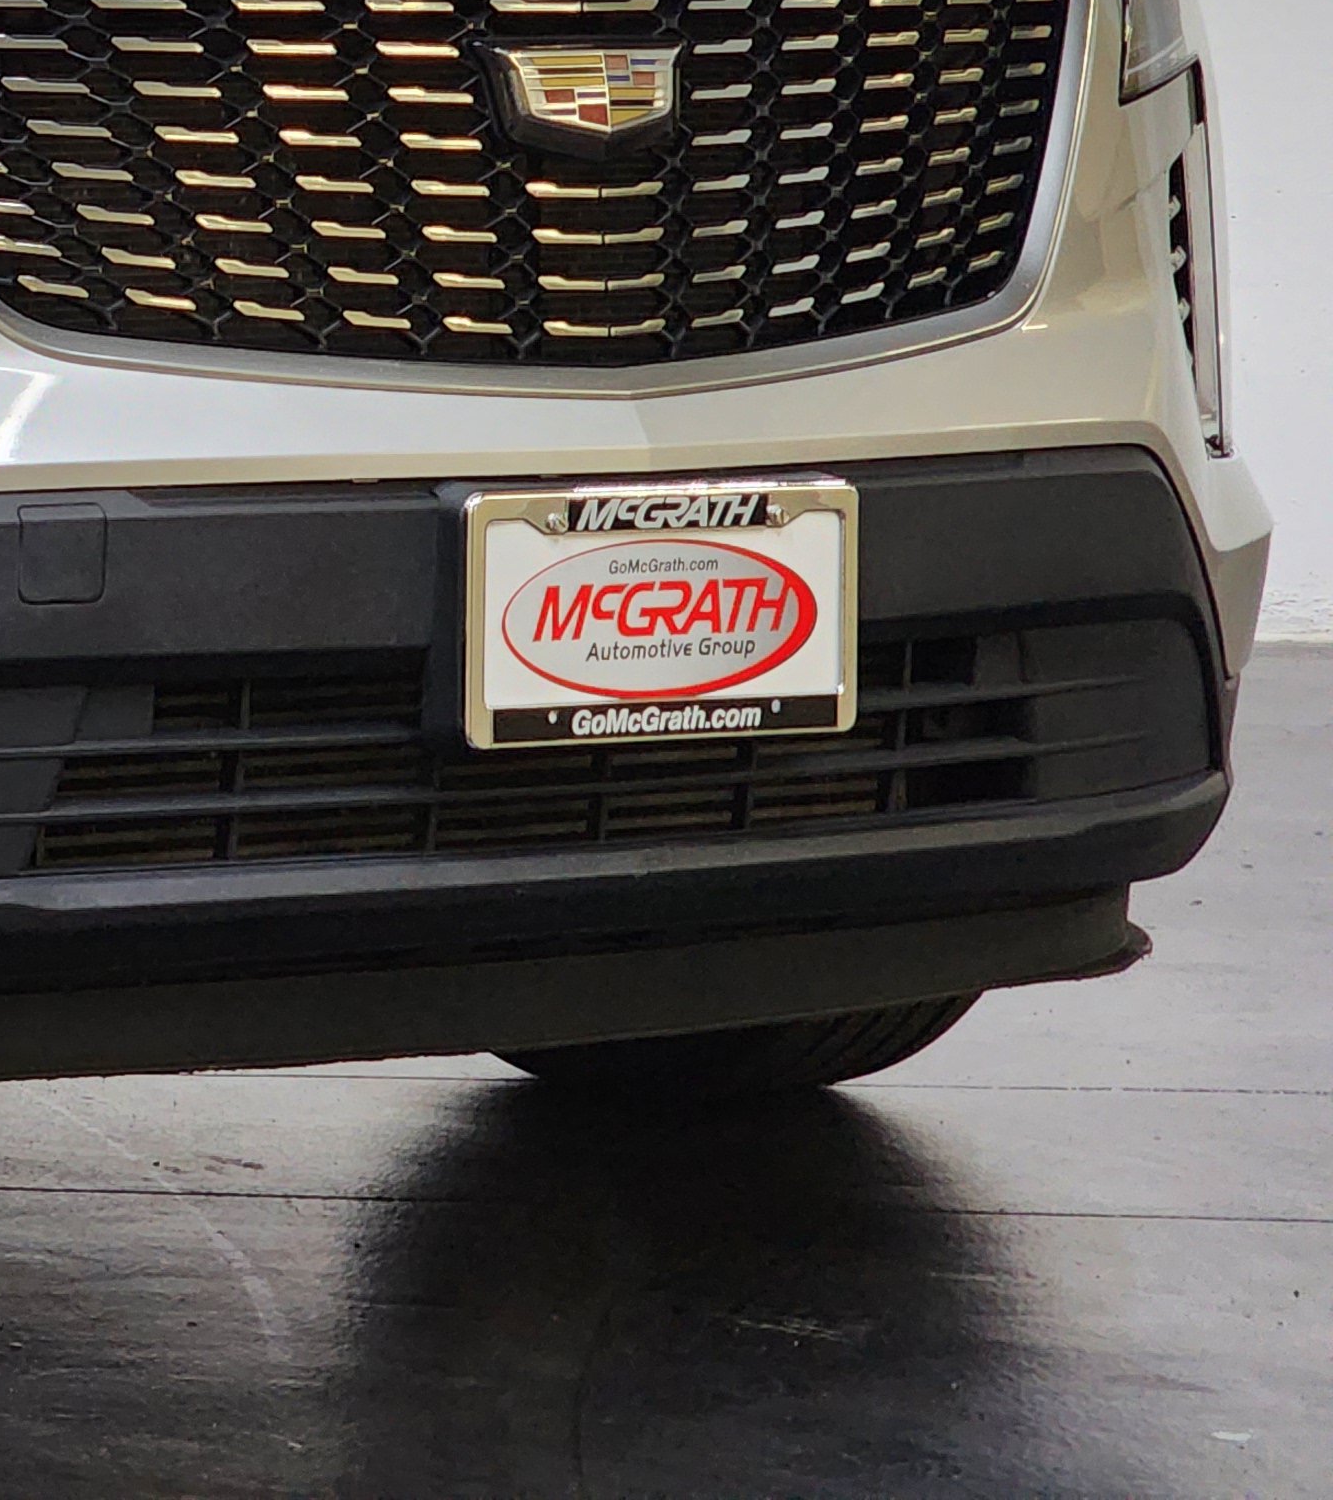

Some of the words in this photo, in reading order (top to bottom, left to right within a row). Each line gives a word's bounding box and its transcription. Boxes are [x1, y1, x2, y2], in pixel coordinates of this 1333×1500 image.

[575, 494, 760, 532] McGRATH
[608, 557, 719, 576] GoMcGrath.com
[532, 577, 793, 642] McGRATH
[585, 639, 693, 663] Automotive
[698, 636, 757, 660] Group
[571, 705, 762, 736] GoMcGrath.com
